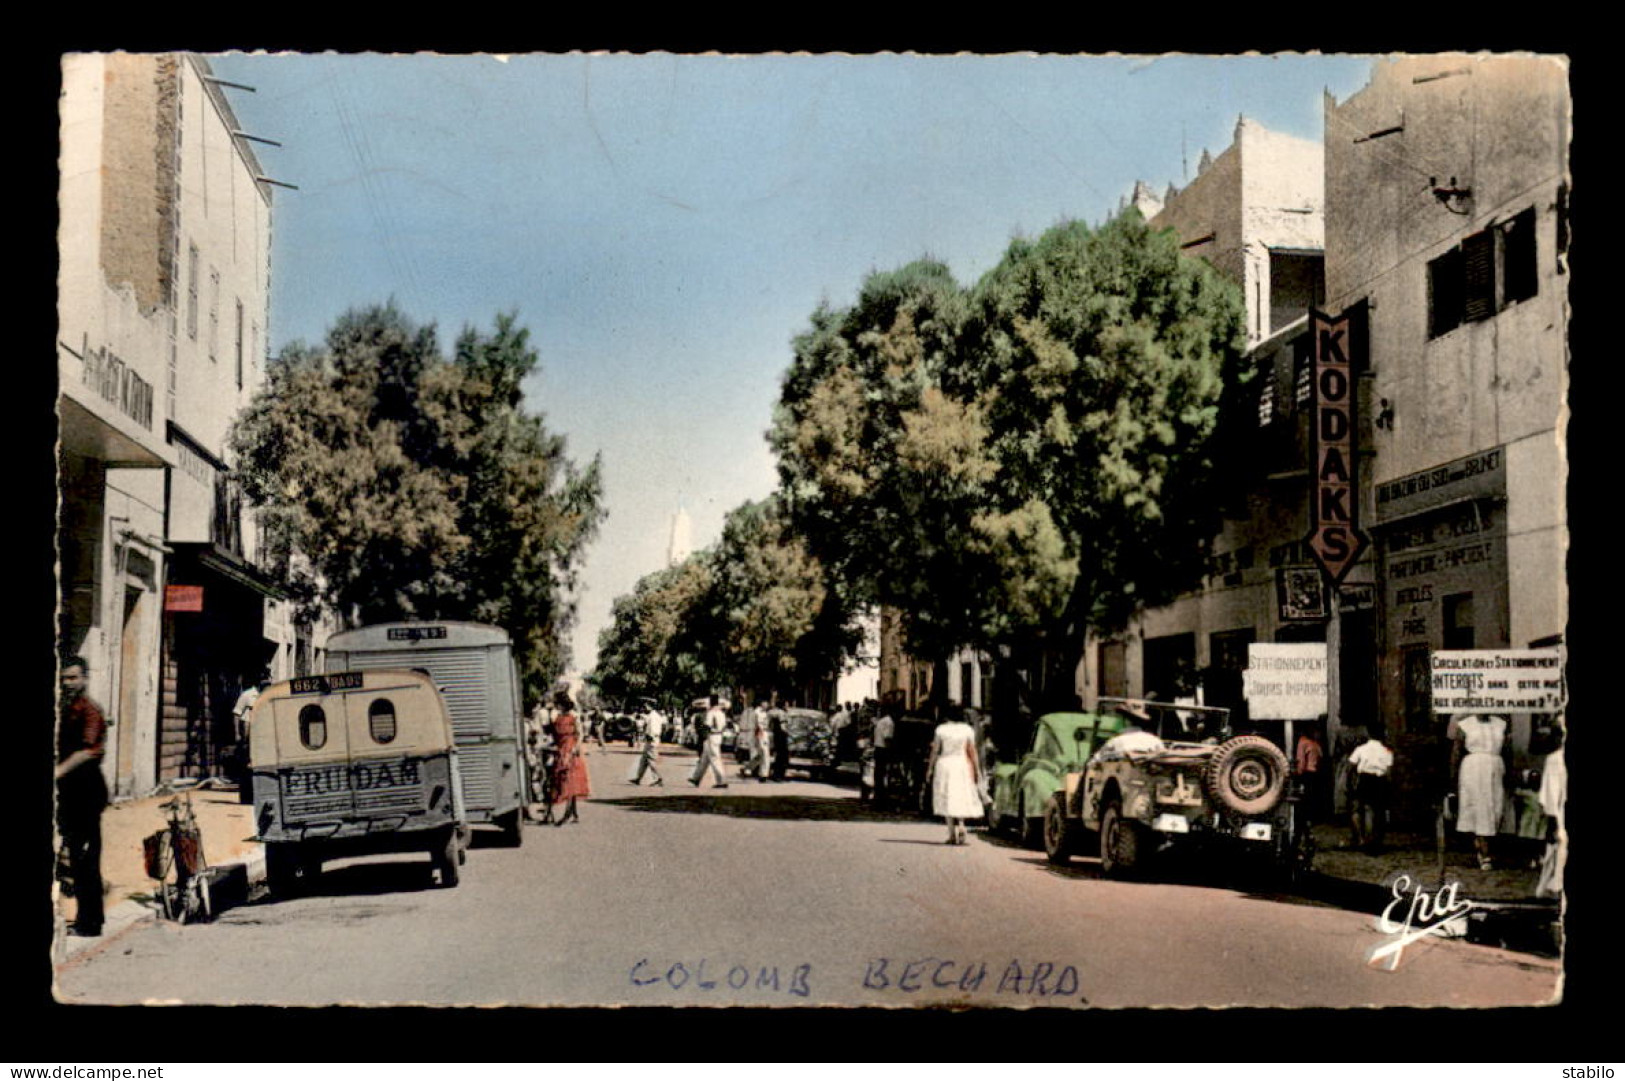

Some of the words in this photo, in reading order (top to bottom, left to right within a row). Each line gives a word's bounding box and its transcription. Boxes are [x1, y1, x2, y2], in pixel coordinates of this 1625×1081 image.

[1318, 328, 1350, 563] KODAKS
[1465, 450, 1500, 477] BRUNET
[1248, 654, 1328, 670] STATIONNEMENT
[1432, 656, 1485, 670] CIRCULATION
[1495, 655, 1560, 669] STATIONNEMENT
[1249, 679, 1283, 696] JOURS
[1285, 679, 1328, 696] IMPAIRS
[1432, 673, 1484, 689] INTERDITS
[1517, 680, 1540, 689] CETTE
[1434, 697, 1448, 707] AUX
[1452, 697, 1495, 707] VEHICULES
[284, 761, 422, 795] FRUIDAM
[628, 960, 812, 997] COLOMB
